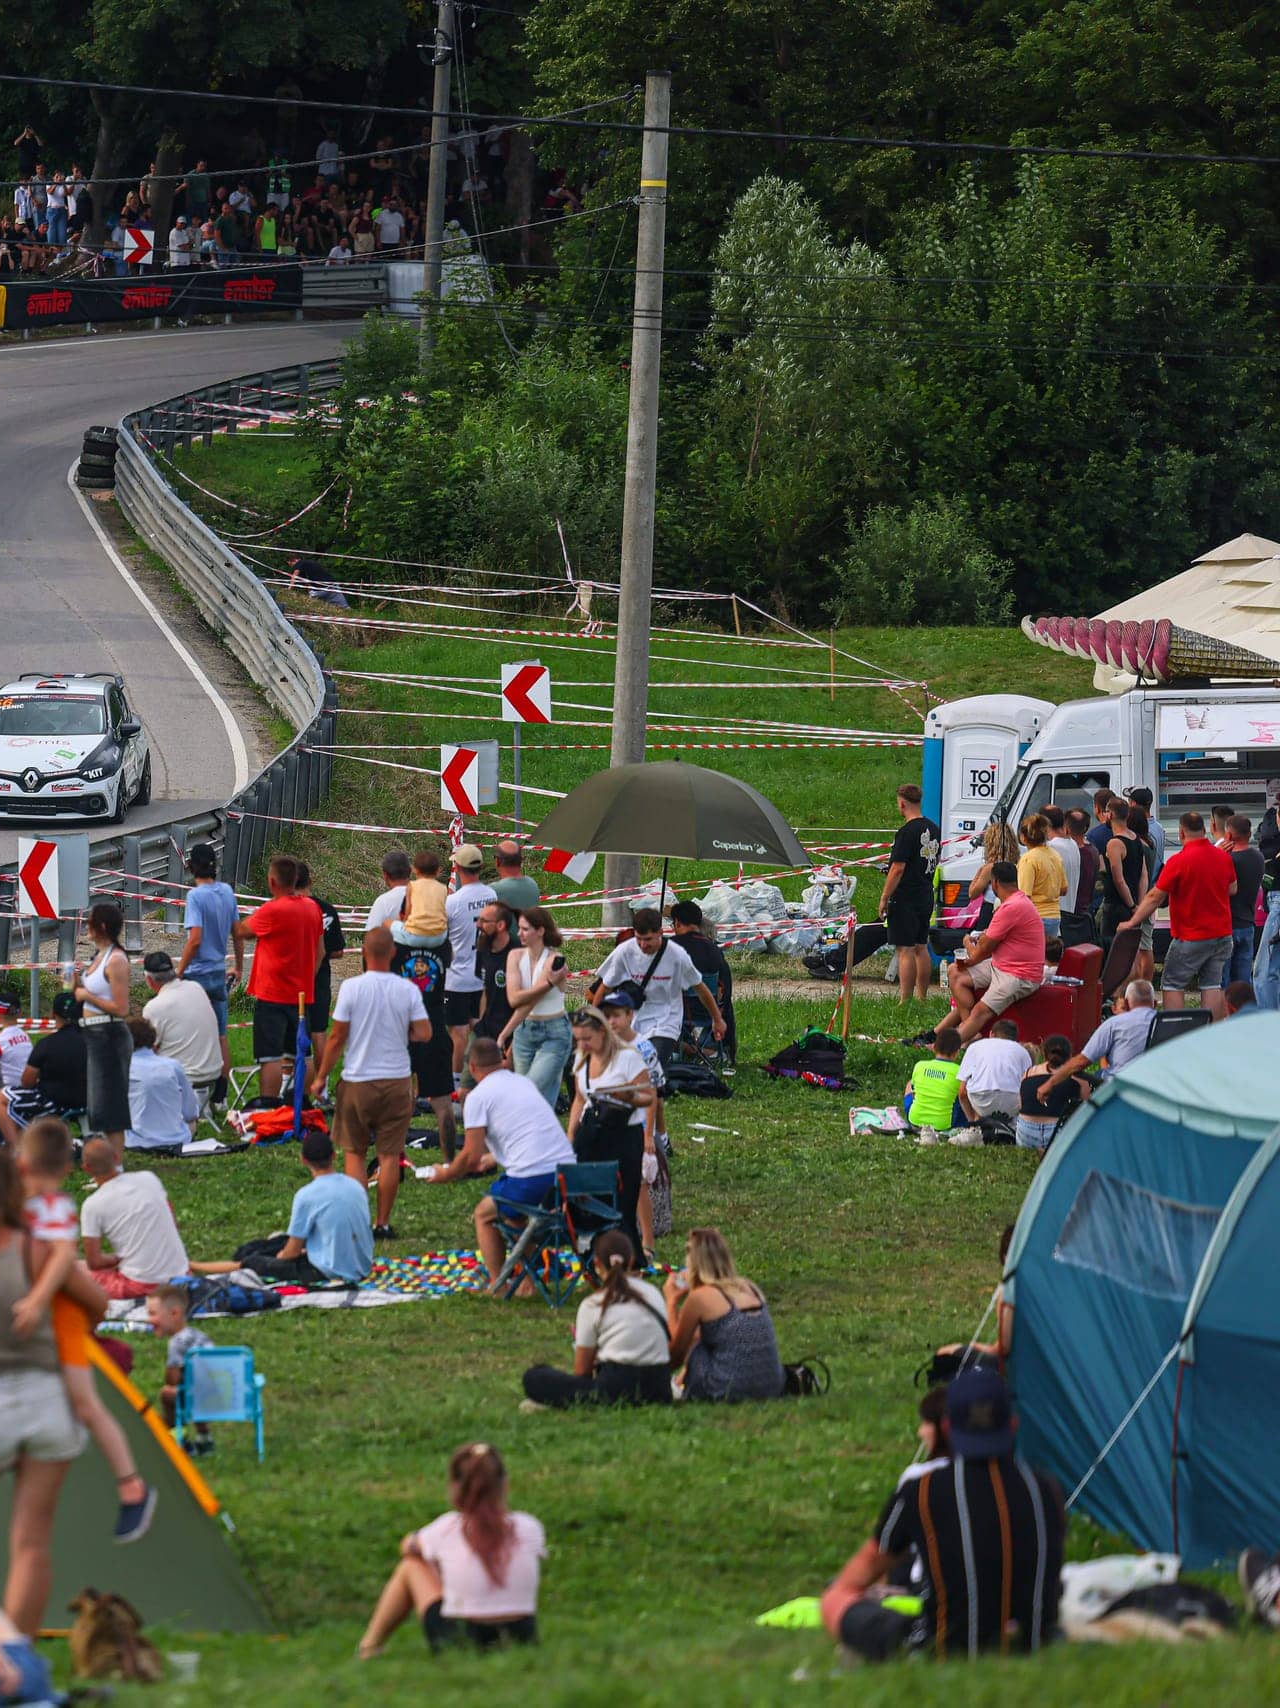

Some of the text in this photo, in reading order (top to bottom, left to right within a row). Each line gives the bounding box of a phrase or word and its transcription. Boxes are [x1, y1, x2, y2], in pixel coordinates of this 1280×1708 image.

[223, 275, 276, 300] emiter
[26, 288, 73, 316] emiter
[121, 284, 173, 309] emiter
[88, 768, 103, 779] KIT
[970, 769, 995, 784] TOI
[970, 784, 994, 797] TOI
[713, 840, 753, 851] Caperlan
